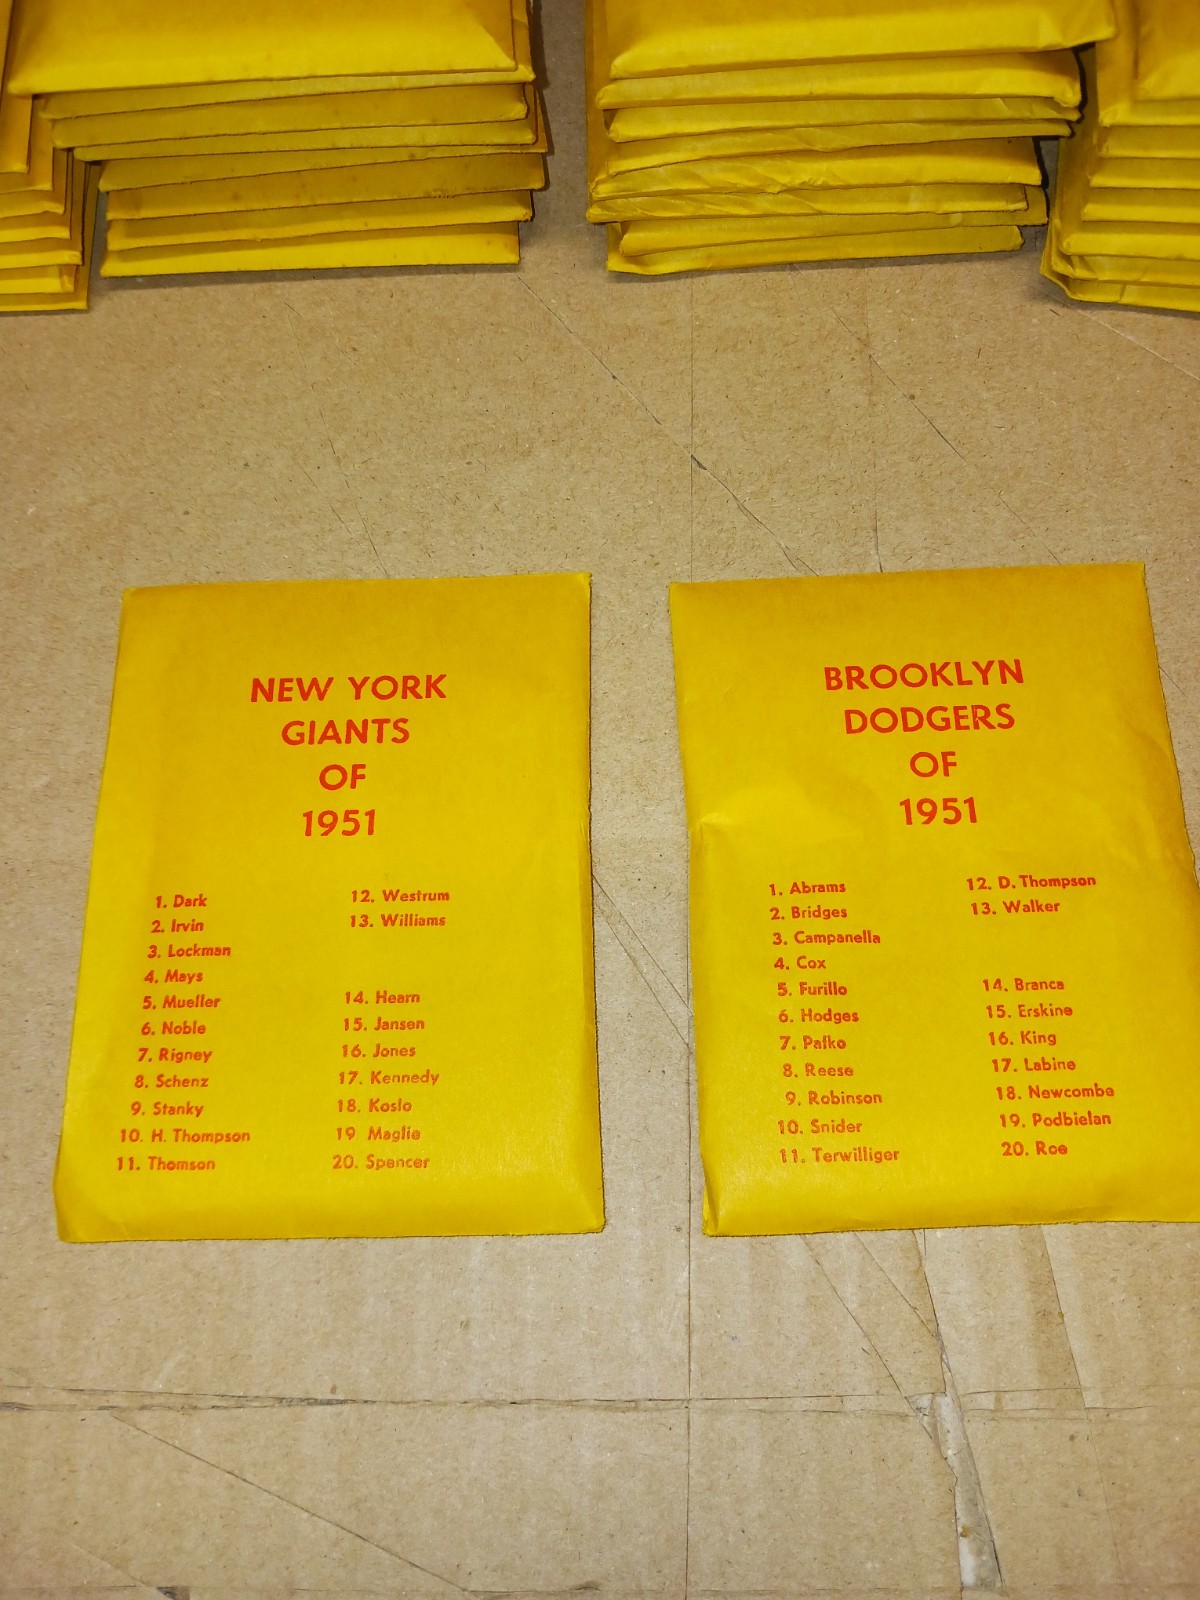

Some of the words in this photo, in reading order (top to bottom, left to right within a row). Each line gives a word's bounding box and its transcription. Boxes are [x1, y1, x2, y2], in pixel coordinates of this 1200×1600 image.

[824, 659, 1023, 690] BROOKLYN
[251, 678, 333, 702] NEW
[348, 674, 446, 700] YORK
[844, 704, 1015, 734] DODGERS
[281, 718, 409, 746] GIANTS
[910, 752, 957, 778] OF
[320, 764, 366, 791] OF
[900, 797, 976, 825] 1951
[304, 810, 375, 837] 1951
[770, 884, 782, 897] 1.
[790, 881, 846, 894] Abrams
[967, 877, 991, 891] 12.
[998, 876, 1016, 889] D.
[1019, 875, 1096, 888] Thompson
[156, 896, 167, 908] 1.
[173, 894, 206, 908] Dark
[352, 889, 375, 903] 12.
[382, 889, 450, 902] Westrum
[770, 907, 785, 921] 2.
[791, 904, 847, 920] Bridges
[972, 902, 996, 915] 13.
[1004, 899, 1059, 912] Walker
[151, 920, 164, 933] 2.
[171, 920, 204, 932] Irvin
[351, 914, 373, 928] 13.
[381, 914, 446, 927] Williams
[773, 932, 787, 946] 3.
[794, 930, 880, 944] Campanella
[148, 945, 161, 958] 3.
[168, 944, 231, 958] Lockman
[774, 958, 789, 970] 4.
[796, 955, 825, 970] Cox
[144, 970, 158, 984] 4.
[165, 969, 203, 984] Mays
[778, 982, 791, 996] 5.
[799, 982, 847, 996] Furillo
[983, 978, 1008, 992] 14.
[1014, 978, 1064, 991] Branca
[143, 996, 156, 1010] 5.
[162, 994, 220, 1008] Mueller
[346, 992, 368, 1004] 14.
[376, 991, 420, 1004] Hearn
[778, 1010, 793, 1024] 6.
[801, 1008, 859, 1024] Hodges
[986, 1004, 1011, 1019] 15.
[1018, 1004, 1072, 1018] Erskine
[141, 1022, 155, 1036] 6.
[162, 1021, 206, 1035] Noble
[344, 1018, 367, 1032] 15.
[374, 1017, 425, 1031] Jansen
[780, 1036, 796, 1051] 7.
[803, 1035, 847, 1050] Pafko
[989, 1031, 1013, 1046] 16.
[1020, 1030, 1056, 1046] King
[138, 1047, 153, 1062] 7.
[158, 1047, 212, 1063] Rigney
[343, 1045, 365, 1058] 16.
[373, 1044, 415, 1058] Jones
[783, 1064, 798, 1078] 8.
[805, 1063, 854, 1077] Reese
[992, 1058, 1017, 1072] 17.
[1024, 1058, 1076, 1071] Labine
[135, 1074, 148, 1088] 8.
[156, 1074, 208, 1088] Schenz
[340, 1071, 362, 1085] 17.
[370, 1069, 439, 1085] Kennedy
[785, 1092, 801, 1105] 9.
[808, 1090, 882, 1105] Robinson
[996, 1086, 1022, 1100] 18.
[1028, 1083, 1115, 1099] Newcombe
[131, 1102, 145, 1115] 9.
[153, 1102, 204, 1118] Stanky
[338, 1099, 360, 1113] 18.
[369, 1098, 412, 1112] Koslo
[778, 1120, 803, 1135] 10.
[811, 1119, 862, 1134] Snider
[1000, 1113, 1025, 1128] 19.
[1032, 1111, 1112, 1127] Podbielan
[121, 1128, 143, 1143] 10.
[151, 1129, 167, 1142] H.
[173, 1128, 250, 1144] Thompson
[368, 1126, 420, 1142] Maglie
[781, 1149, 805, 1163] 11.
[813, 1146, 899, 1164] Terwilliger
[1002, 1141, 1028, 1156] 20.
[1036, 1140, 1068, 1155] Roe
[118, 1157, 140, 1171] 11.
[148, 1156, 215, 1171] Thomson
[333, 1154, 358, 1169] 20.
[366, 1154, 428, 1170] Spencer
